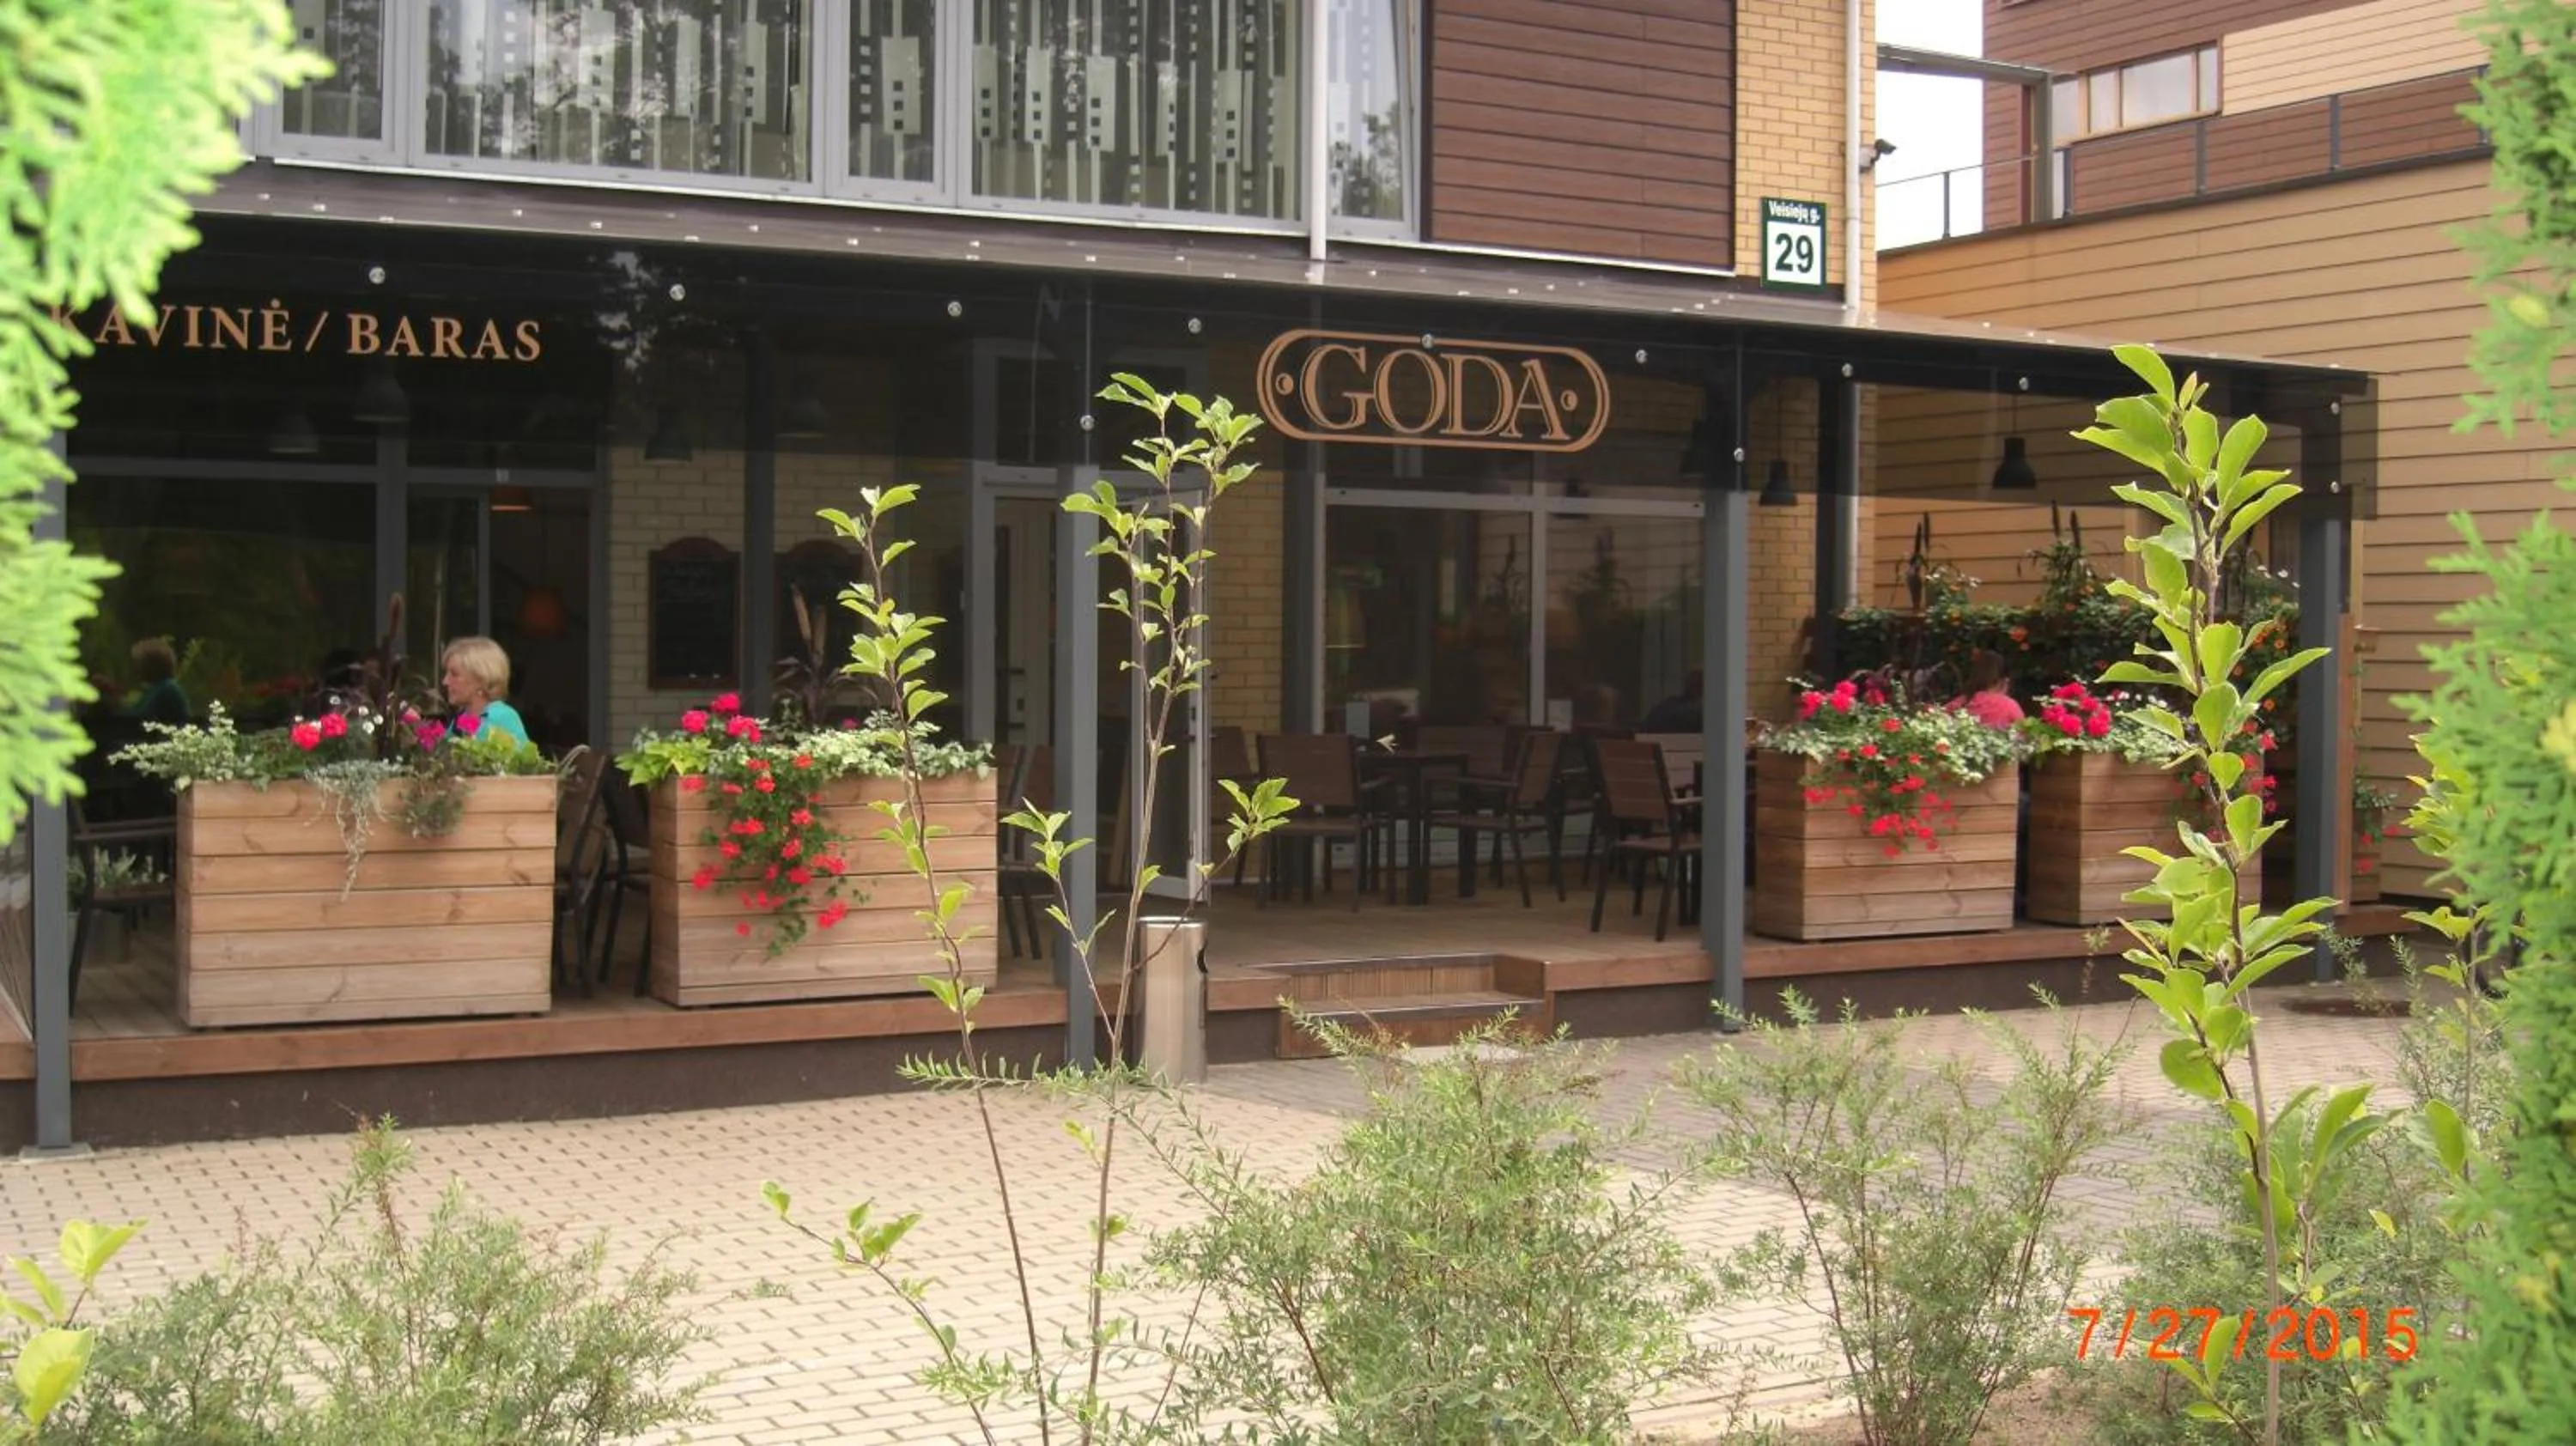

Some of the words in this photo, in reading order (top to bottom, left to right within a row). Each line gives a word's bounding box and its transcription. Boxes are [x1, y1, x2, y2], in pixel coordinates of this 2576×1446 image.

[1775, 232, 1814, 274] 29
[347, 313, 541, 361] BARAS
[1299, 343, 1571, 440] GODA
